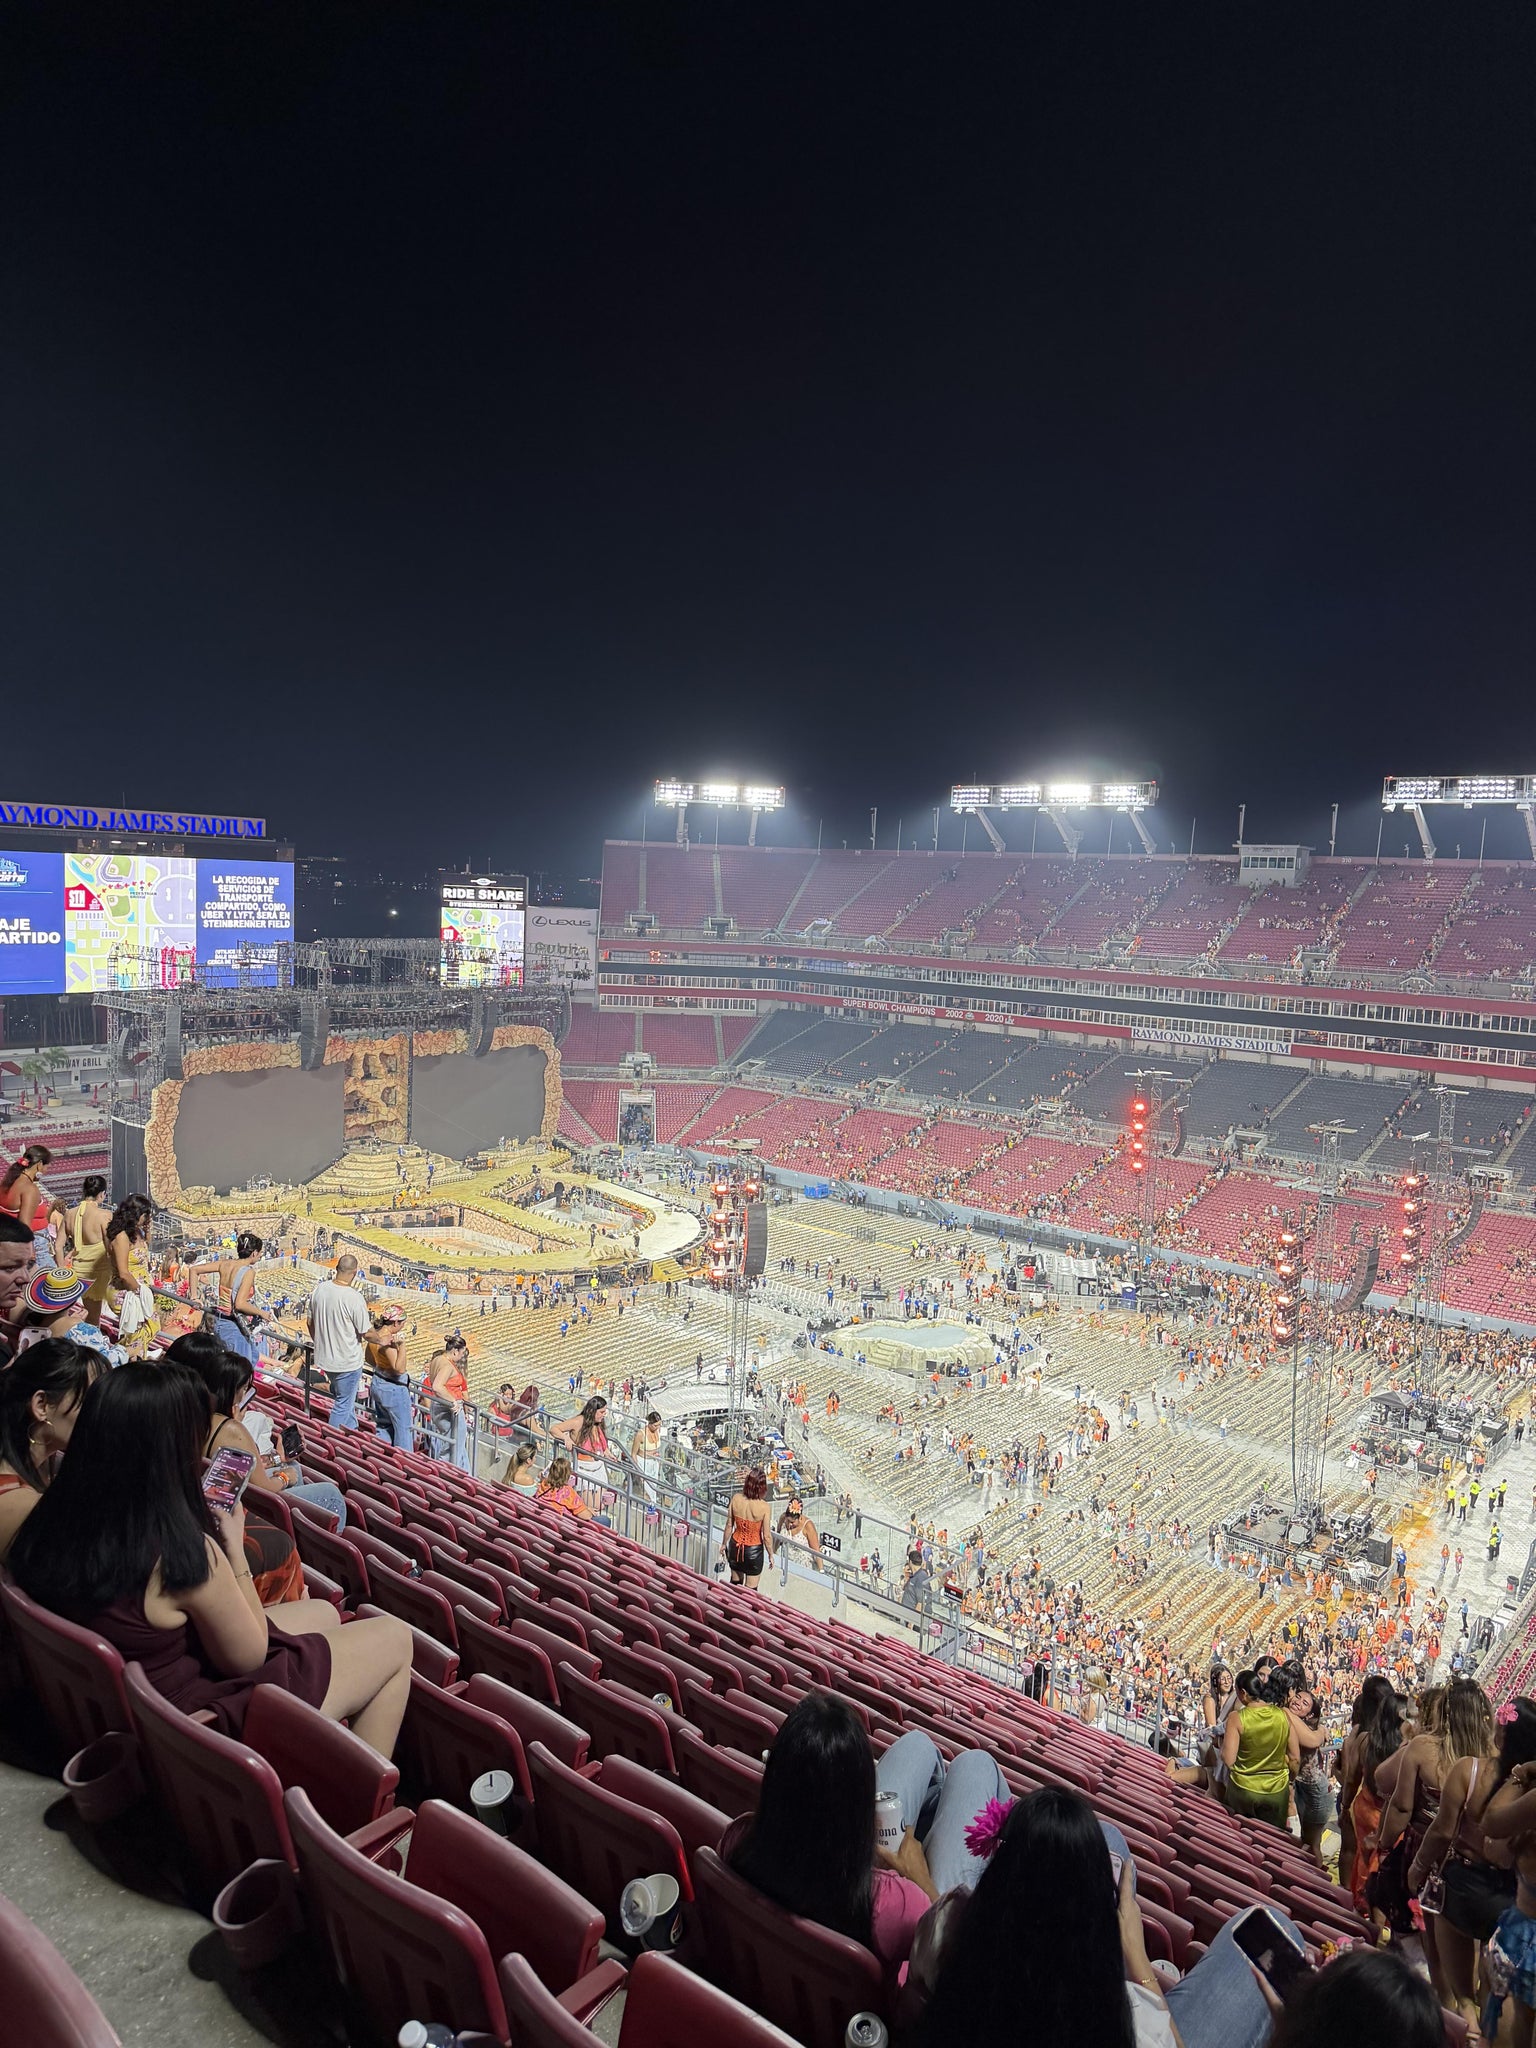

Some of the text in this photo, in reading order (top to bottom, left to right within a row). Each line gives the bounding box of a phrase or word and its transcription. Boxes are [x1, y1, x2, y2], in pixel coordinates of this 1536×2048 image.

[102, 811, 173, 832] JAMES
[177, 815, 264, 837] STADIUM
[212, 875, 280, 886] LA RECOGIDA DE
[218, 884, 275, 894] SERVICIOS DE
[443, 888, 524, 901] RIDE SHARE
[219, 893, 274, 903] TRANSPORTE
[205, 902, 286, 912] COMPARTIDO, COMO
[200, 911, 224, 919] UBER
[225, 911, 232, 919] Y
[233, 911, 255, 921] LYFT,
[279, 912, 290, 920] EN
[203, 920, 291, 929] STEINBRENNER FIELD
[843, 999, 866, 1008] SUPER
[868, 1001, 889, 1011] BOWL
[891, 1004, 936, 1016] CHAMPIONS
[945, 1010, 964, 1019] 2002
[984, 1013, 1004, 1023] 2020
[1133, 1029, 1290, 1054] RAYMOND JAMES STADIUM
[82, 1057, 102, 1067] GRILL
[716, 1493, 729, 1505] 340
[824, 1535, 838, 1547] 341
